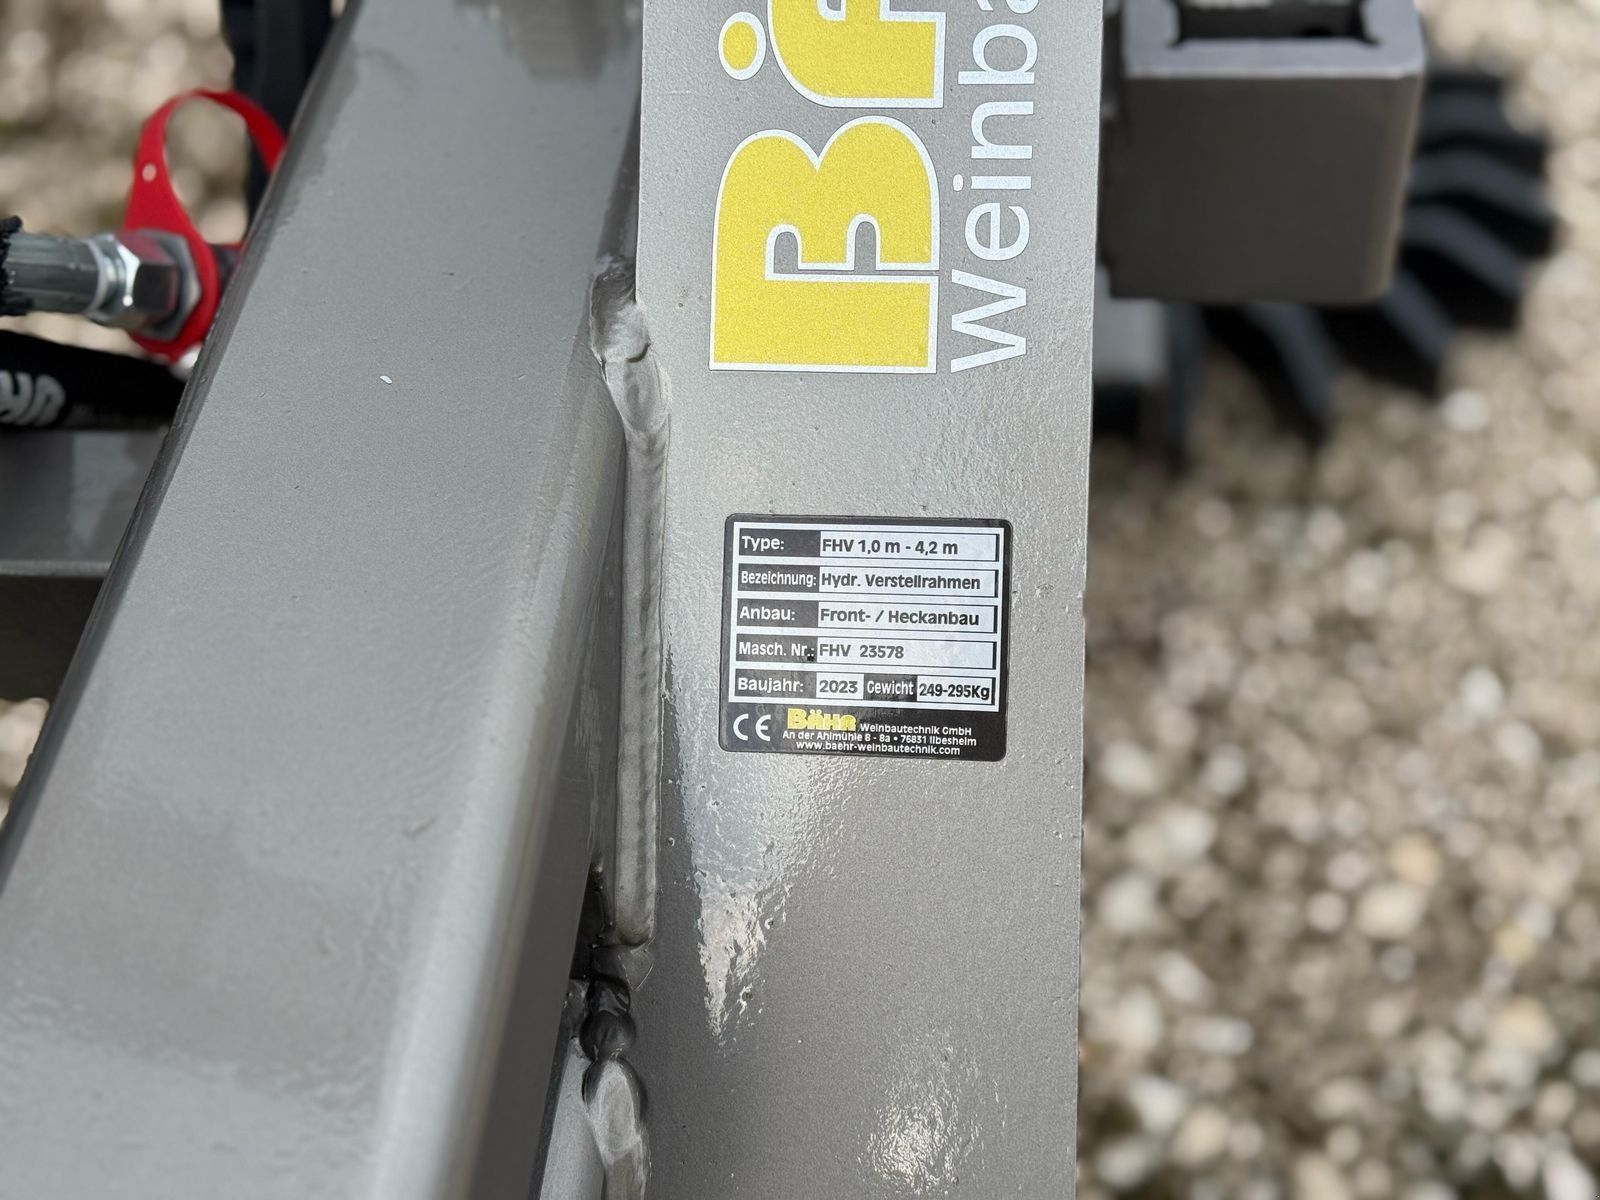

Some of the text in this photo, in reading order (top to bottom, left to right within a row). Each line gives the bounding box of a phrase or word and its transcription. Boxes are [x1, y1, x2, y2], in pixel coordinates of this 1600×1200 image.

[951, 0, 1038, 373] Weinb
[741, 535, 785, 552] Type:
[822, 538, 855, 552] FHV
[857, 540, 881, 555] 1,0
[885, 541, 901, 553] m
[915, 541, 938, 556] 4,2
[942, 543, 958, 555] m
[741, 570, 981, 590] Bezeichnung: Hydr. Verstellrahmen
[739, 606, 980, 626] Anbau: Front- / Heckanbau
[738, 642, 904, 659] Masch. Nr.: FHV 23578
[737, 678, 991, 701] Baujahr: 2023 Gewicht 249-295Kg
[782, 730, 796, 740] An
[800, 730, 815, 741] der
[864, 733, 872, 742] 8
[879, 734, 891, 743] 8a
[859, 723, 973, 737] Weinbautechnik GmbH
[795, 740, 961, 756] www.baehr-weinbautechnik.com
